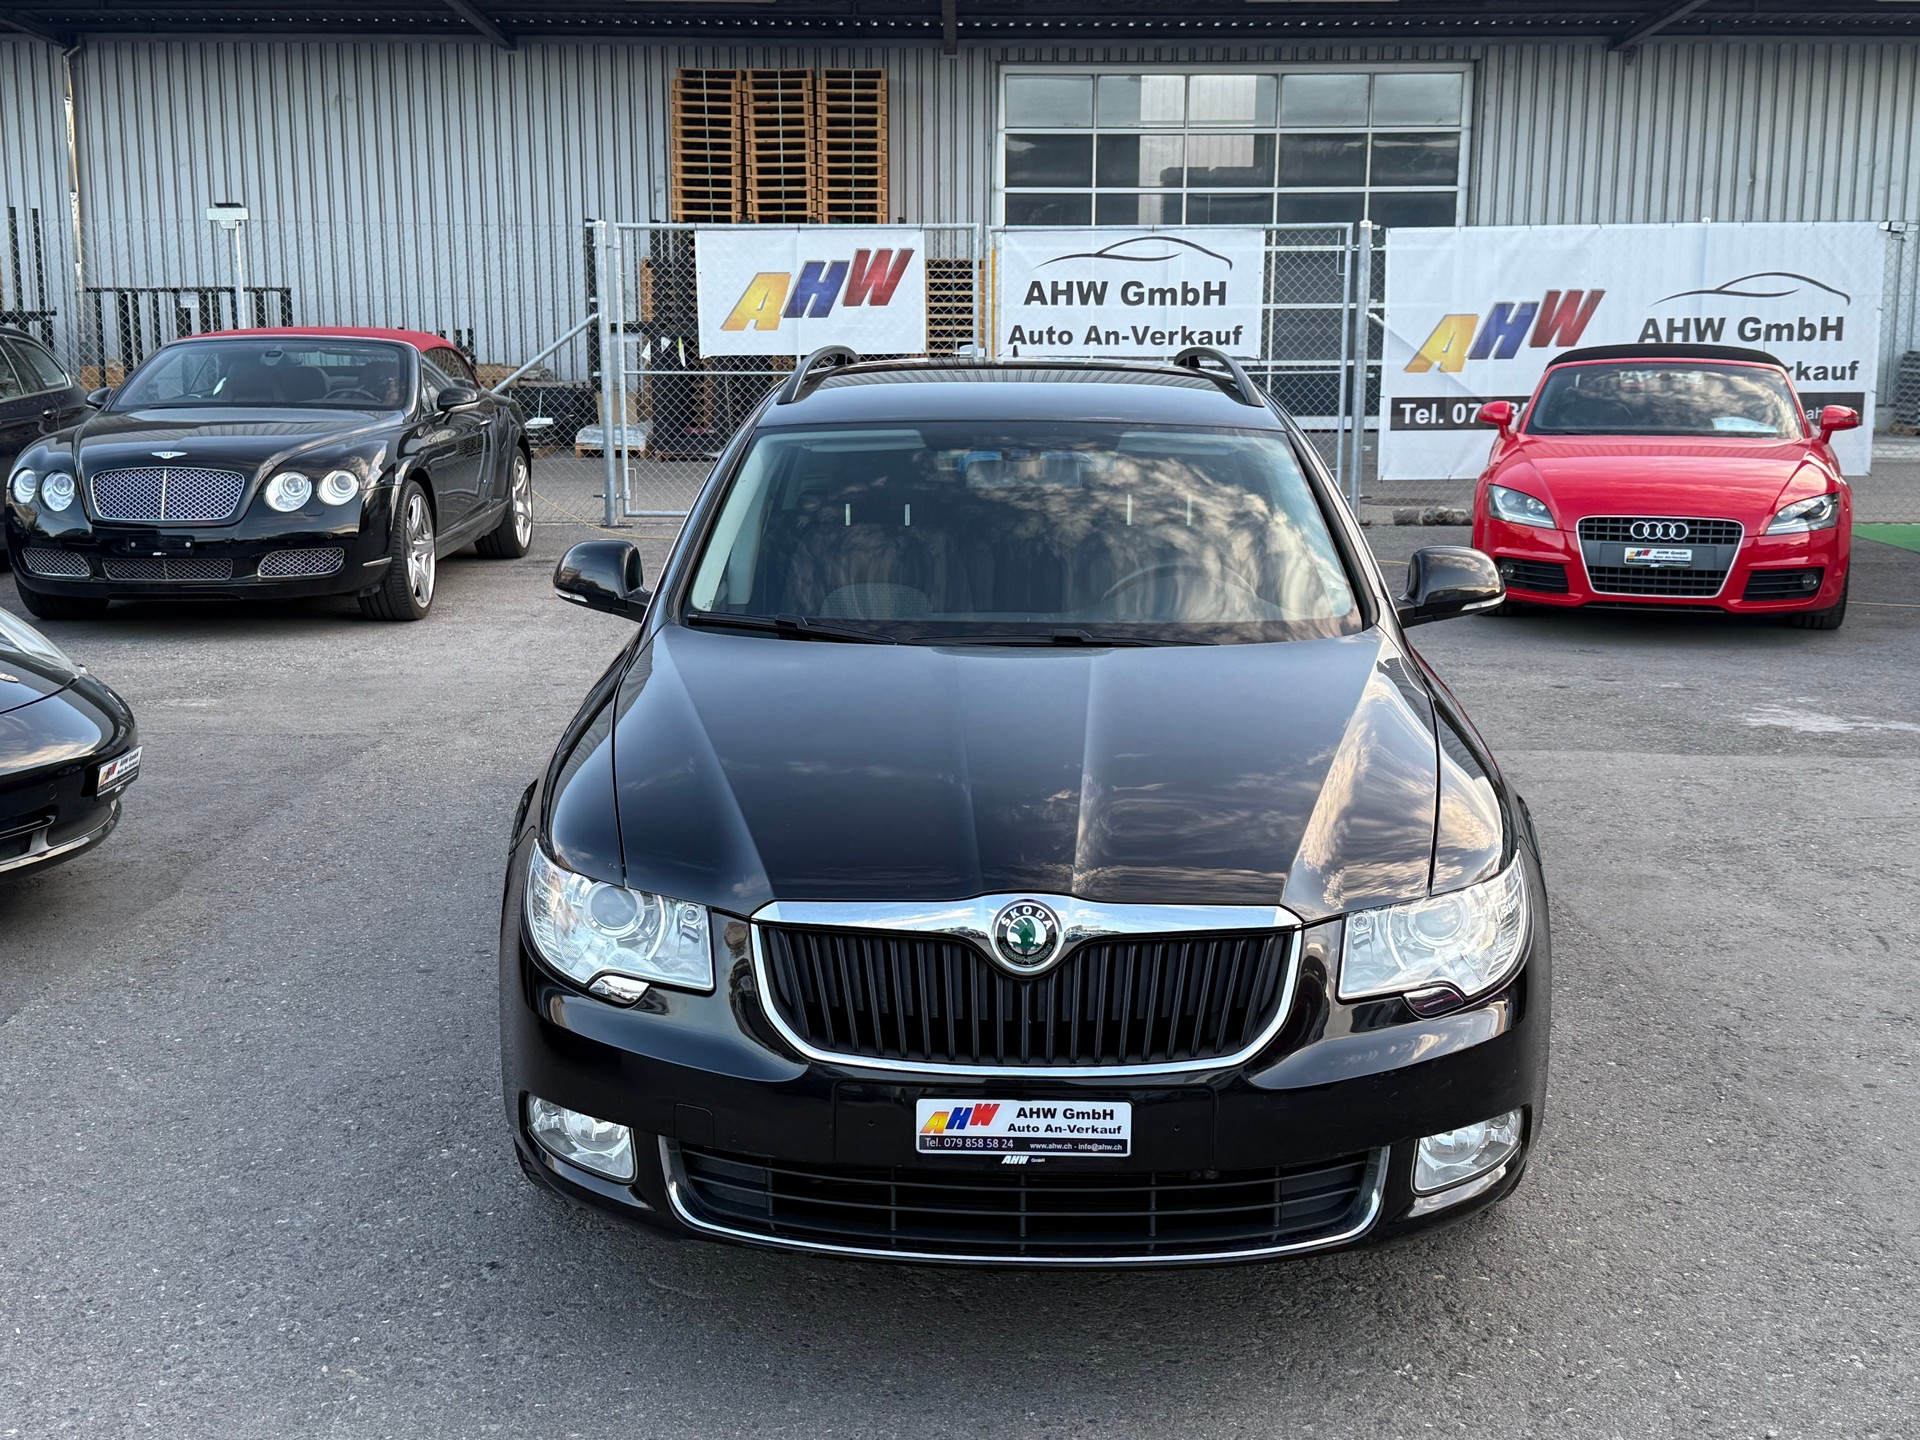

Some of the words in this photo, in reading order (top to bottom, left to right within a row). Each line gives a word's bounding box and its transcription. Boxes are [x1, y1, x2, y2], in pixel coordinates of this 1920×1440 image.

[720, 248, 915, 331] AHW
[1023, 281, 1108, 306] AHW
[1121, 280, 1227, 306] GmbH
[1008, 325, 1074, 345] Auto
[1083, 325, 1243, 346] An-Verkauf
[1403, 289, 1607, 373] AHW
[1638, 317, 1726, 343] AHW
[1738, 316, 1844, 342] GmbH
[1399, 403, 1444, 424] Tel.
[1452, 403, 1482, 424] 07
[920, 1103, 1000, 1134] AHW
[1016, 1107, 1057, 1119] AHW
[1062, 1108, 1114, 1120] GmbH
[1007, 1123, 1040, 1133] Auto
[1044, 1124, 1122, 1134] An-Verkauf
[925, 1138, 941, 1147] Tel.
[944, 1138, 962, 1148] 079
[965, 1138, 984, 1148] 858
[986, 1138, 999, 1148] 58
[1002, 1139, 1014, 1148] 24
[1078, 1142, 1122, 1152] info@ahw.ch
[1001, 1155, 1030, 1164] AHW
